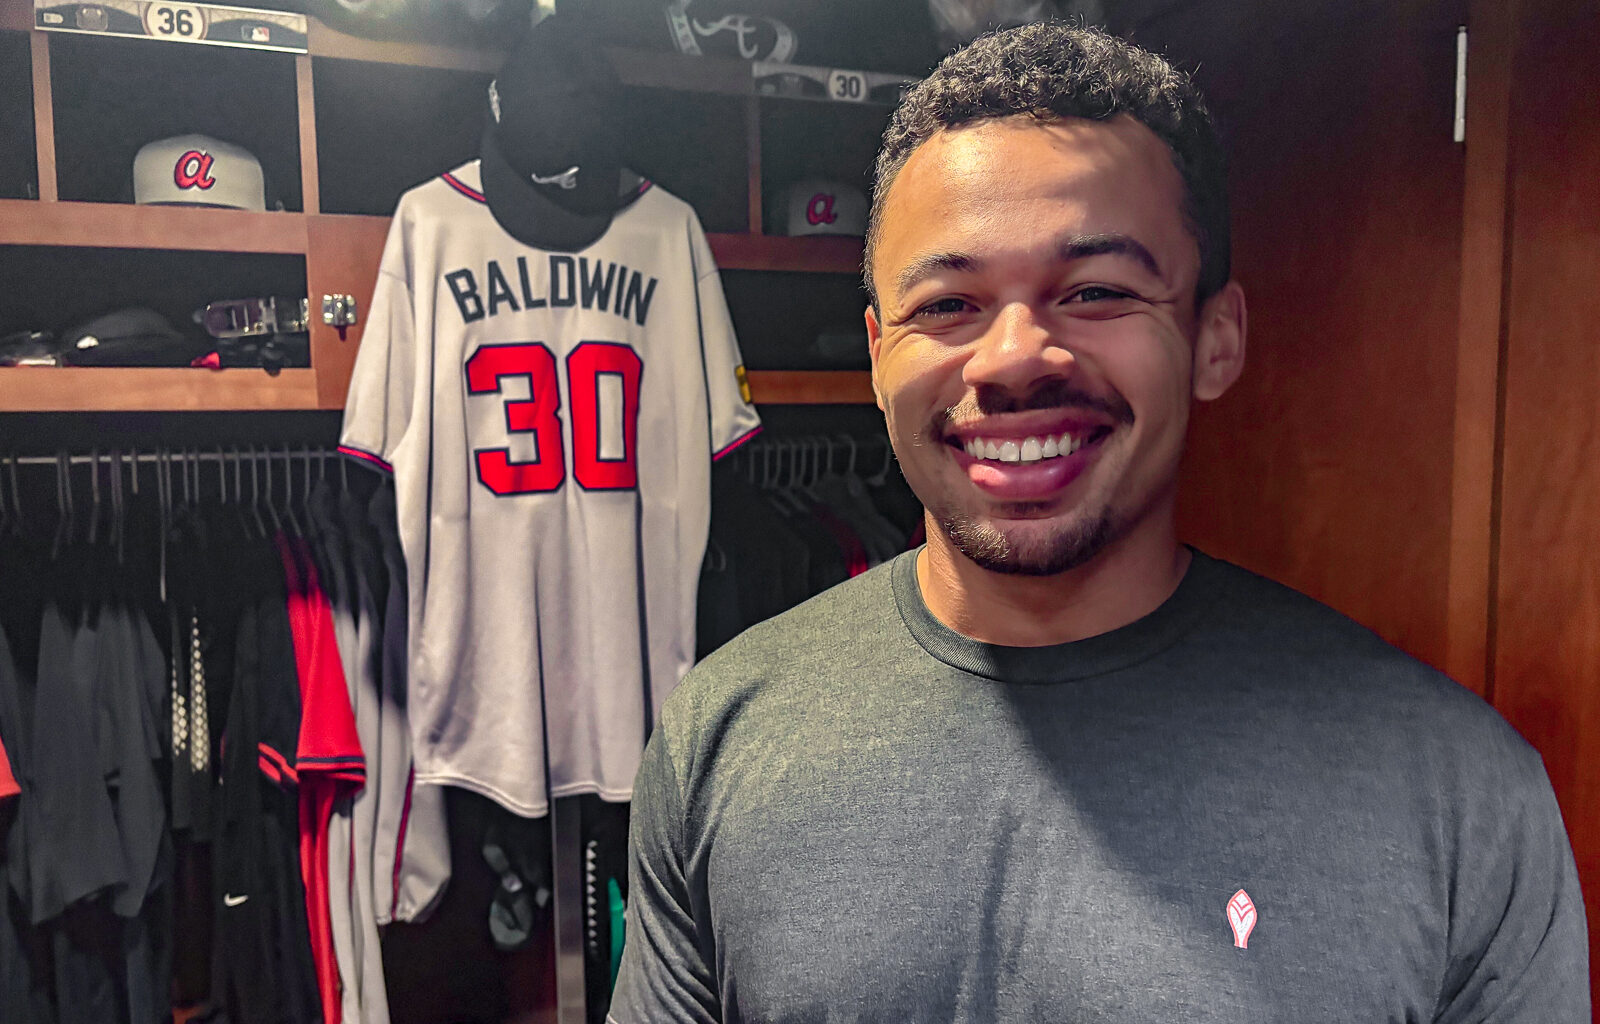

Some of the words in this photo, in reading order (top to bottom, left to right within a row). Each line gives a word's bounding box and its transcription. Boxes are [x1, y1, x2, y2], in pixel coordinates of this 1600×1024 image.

[158, 8, 193, 36] 36
[836, 75, 860, 98] 30
[445, 255, 658, 326] BALDWIN
[465, 341, 644, 496] 30
